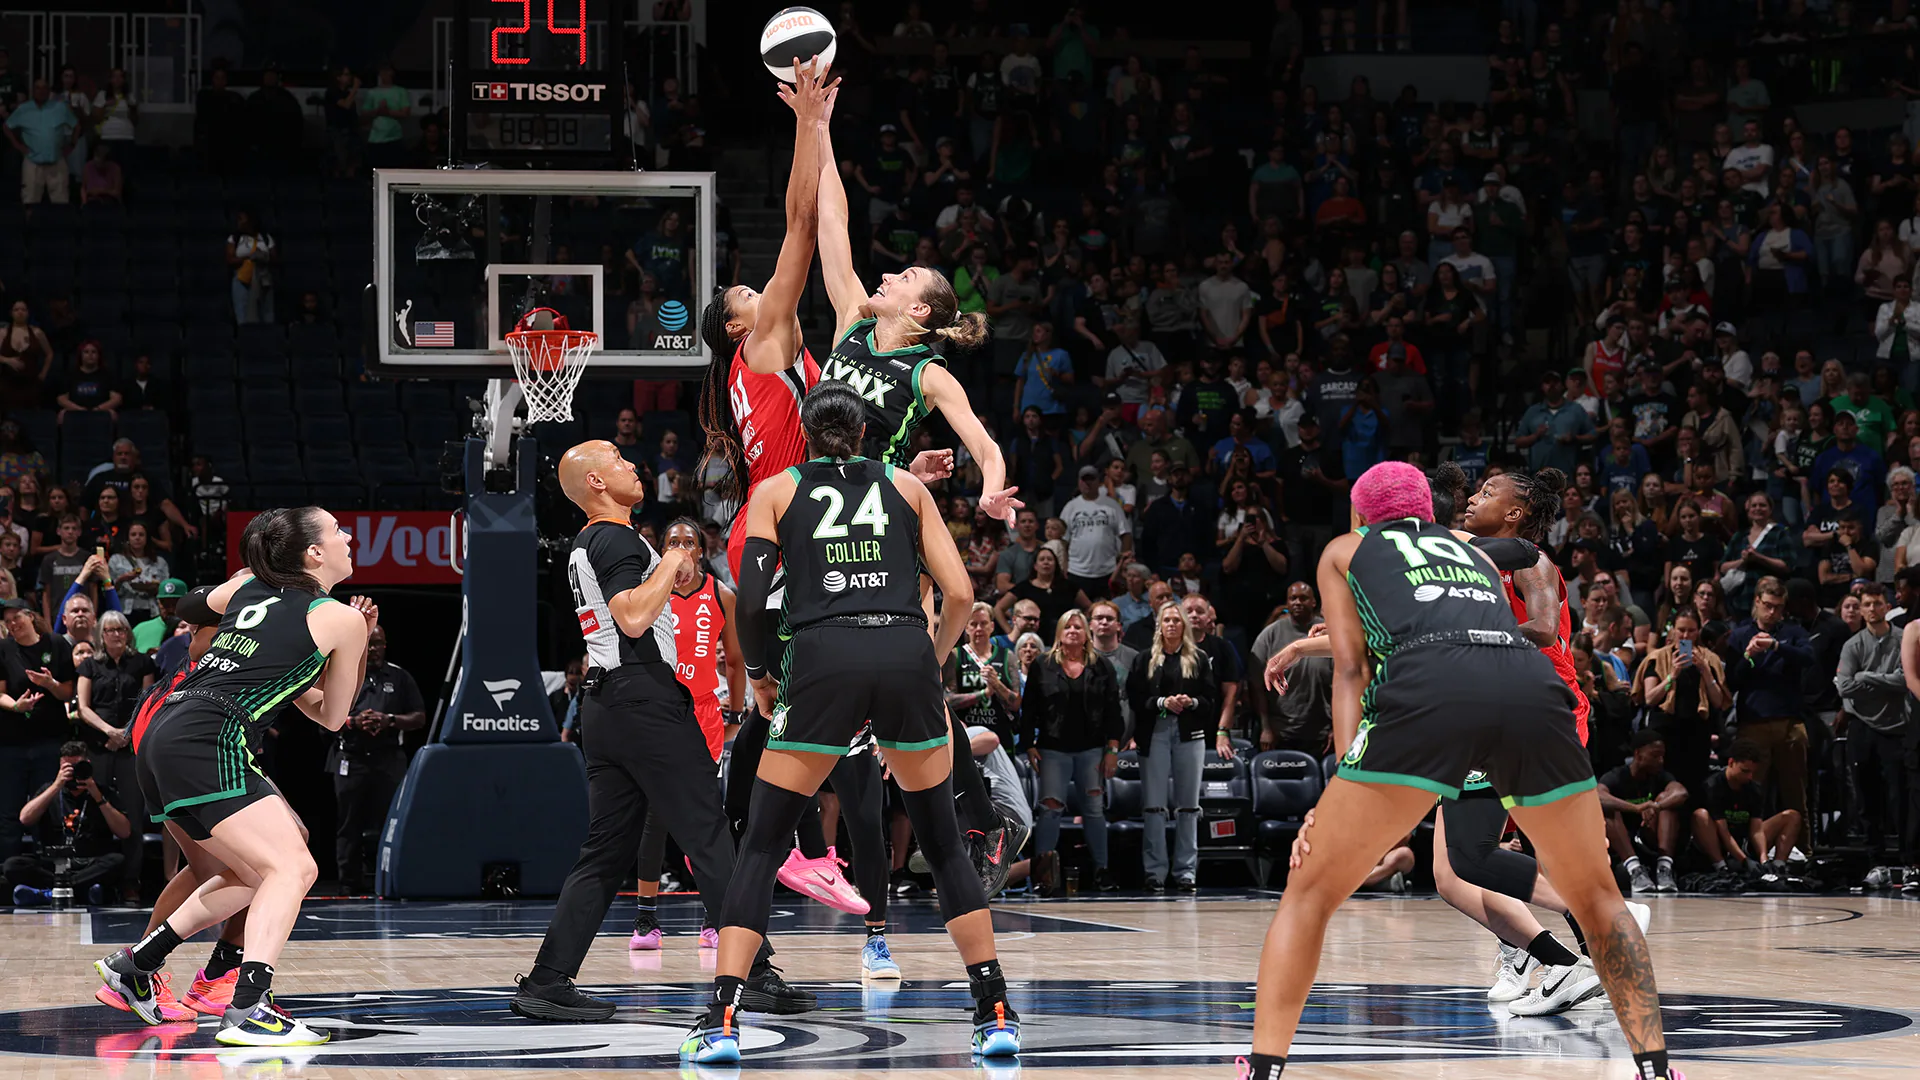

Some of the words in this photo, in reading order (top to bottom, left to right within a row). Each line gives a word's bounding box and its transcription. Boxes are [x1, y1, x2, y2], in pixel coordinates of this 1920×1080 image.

[491, 0, 587, 64] 24
[765, 15, 814, 38] Wilson
[509, 83, 606, 101] TISSOT
[654, 335, 692, 349] AT&T
[832, 352, 898, 386] MINNESOTA
[820, 358, 895, 408] LYNX
[809, 482, 889, 539] 24
[826, 540, 882, 564] COLLIER
[1381, 530, 1475, 568] 10
[850, 572, 889, 589] AT&T
[1405, 565, 1492, 588] WILLIAMS
[699, 593, 712, 601] ally
[1448, 586, 1497, 604] AT&T
[234, 596, 282, 629] 6
[694, 603, 712, 658] ACES
[208, 657, 240, 672] A&T
[676, 662, 695, 680] ng
[463, 713, 540, 731] Fanatics
